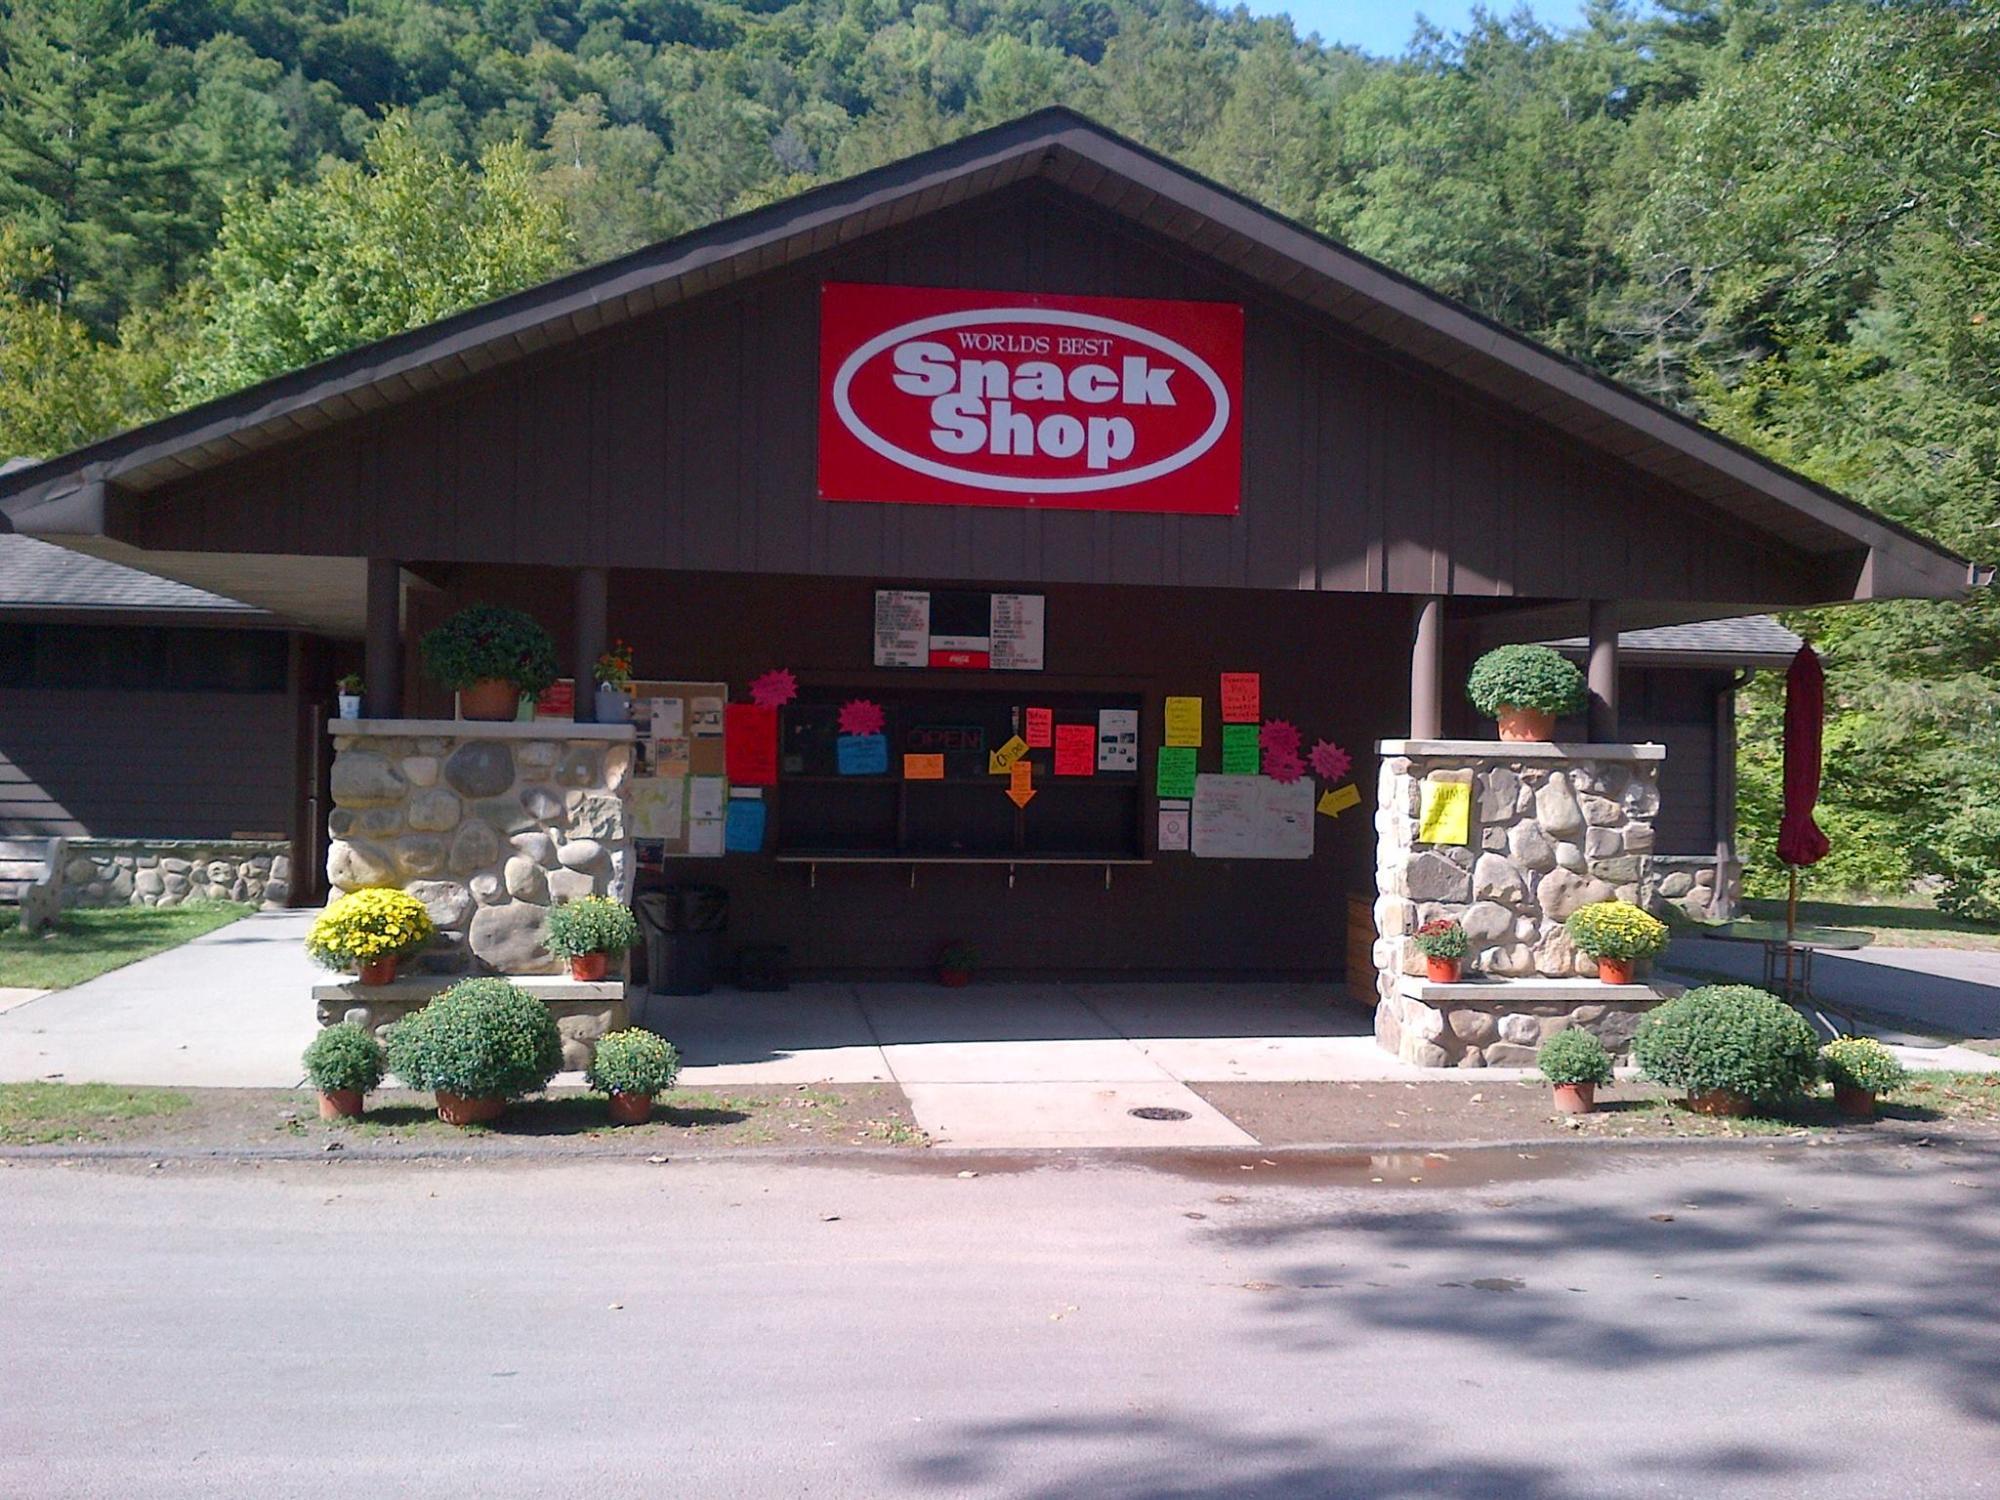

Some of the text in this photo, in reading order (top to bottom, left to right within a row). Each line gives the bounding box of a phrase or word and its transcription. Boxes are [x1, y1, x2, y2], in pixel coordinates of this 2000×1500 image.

[958, 331, 1113, 357] WORLDS BEST
[892, 341, 1177, 406] Snack
[930, 391, 1136, 469] Shop
[907, 729, 979, 748] OPEN
